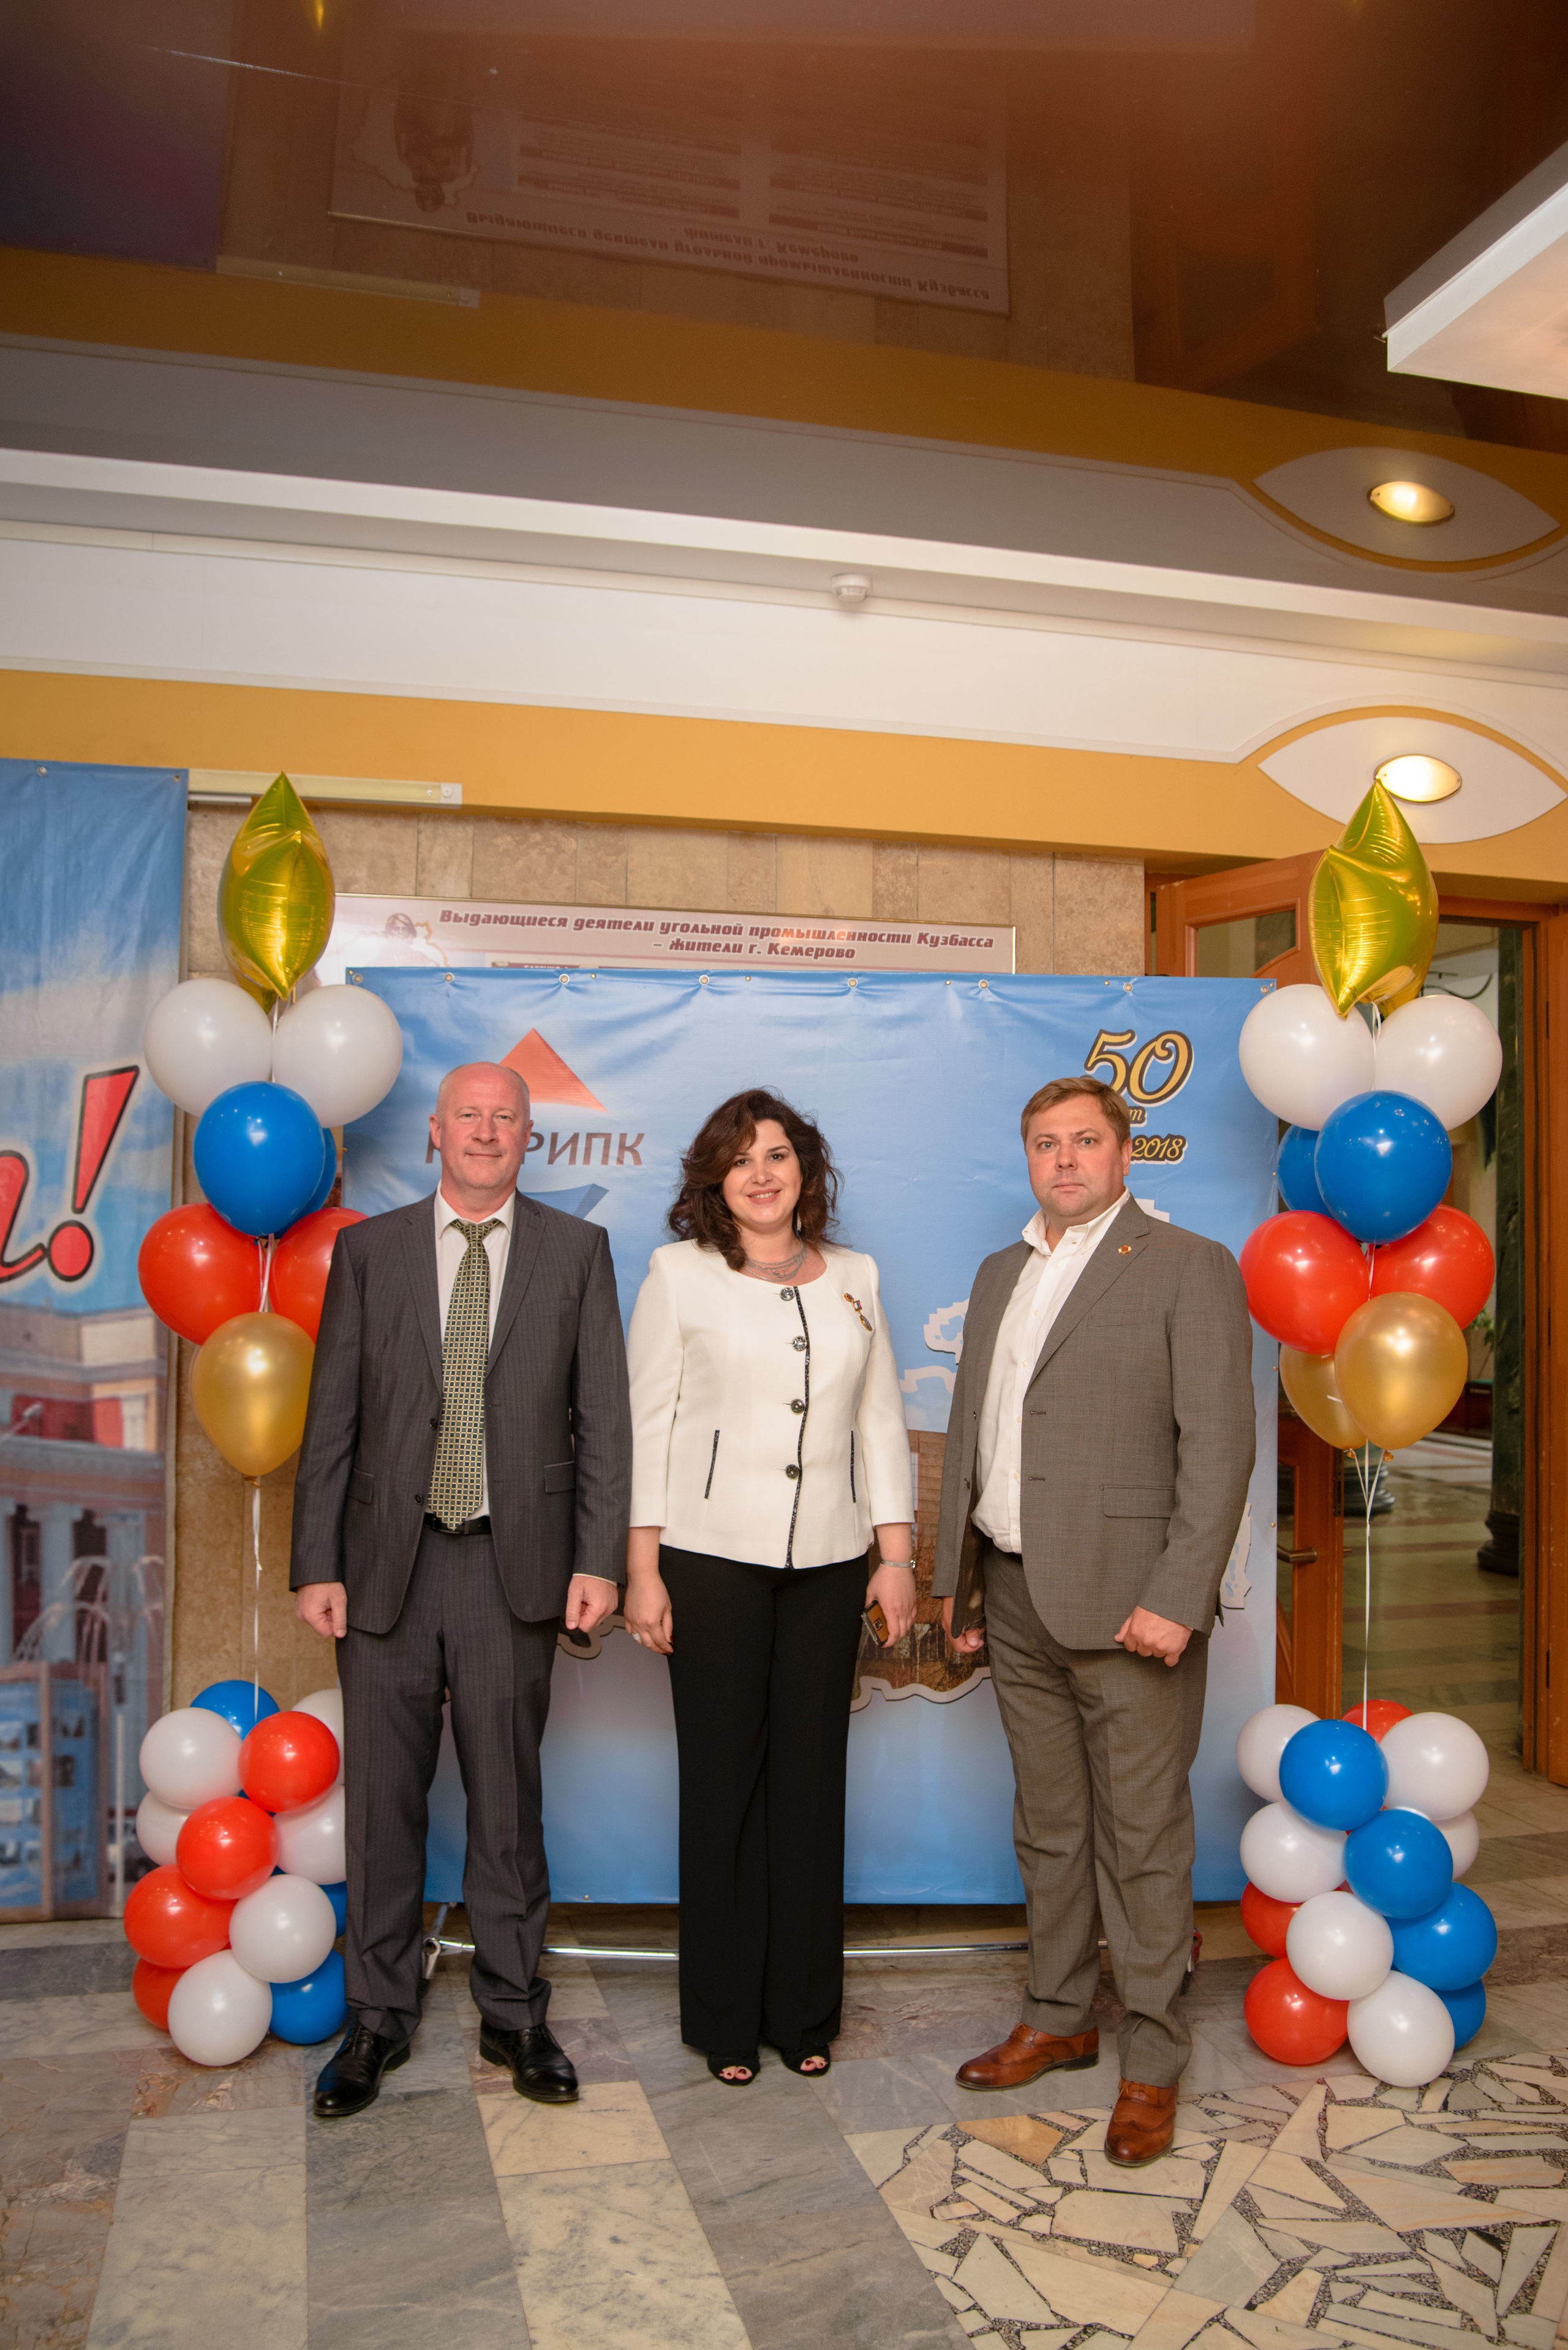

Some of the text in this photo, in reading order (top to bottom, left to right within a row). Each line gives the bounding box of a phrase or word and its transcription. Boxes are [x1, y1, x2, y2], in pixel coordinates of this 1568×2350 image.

[440, 910, 994, 948] Выдающиеся деятели угольной промышленности Кузбасса
[669, 938, 743, 954] жители
[748, 944, 762, 954] г.
[767, 942, 856, 959] Кемерово
[1080, 1029, 1194, 1105] 50
